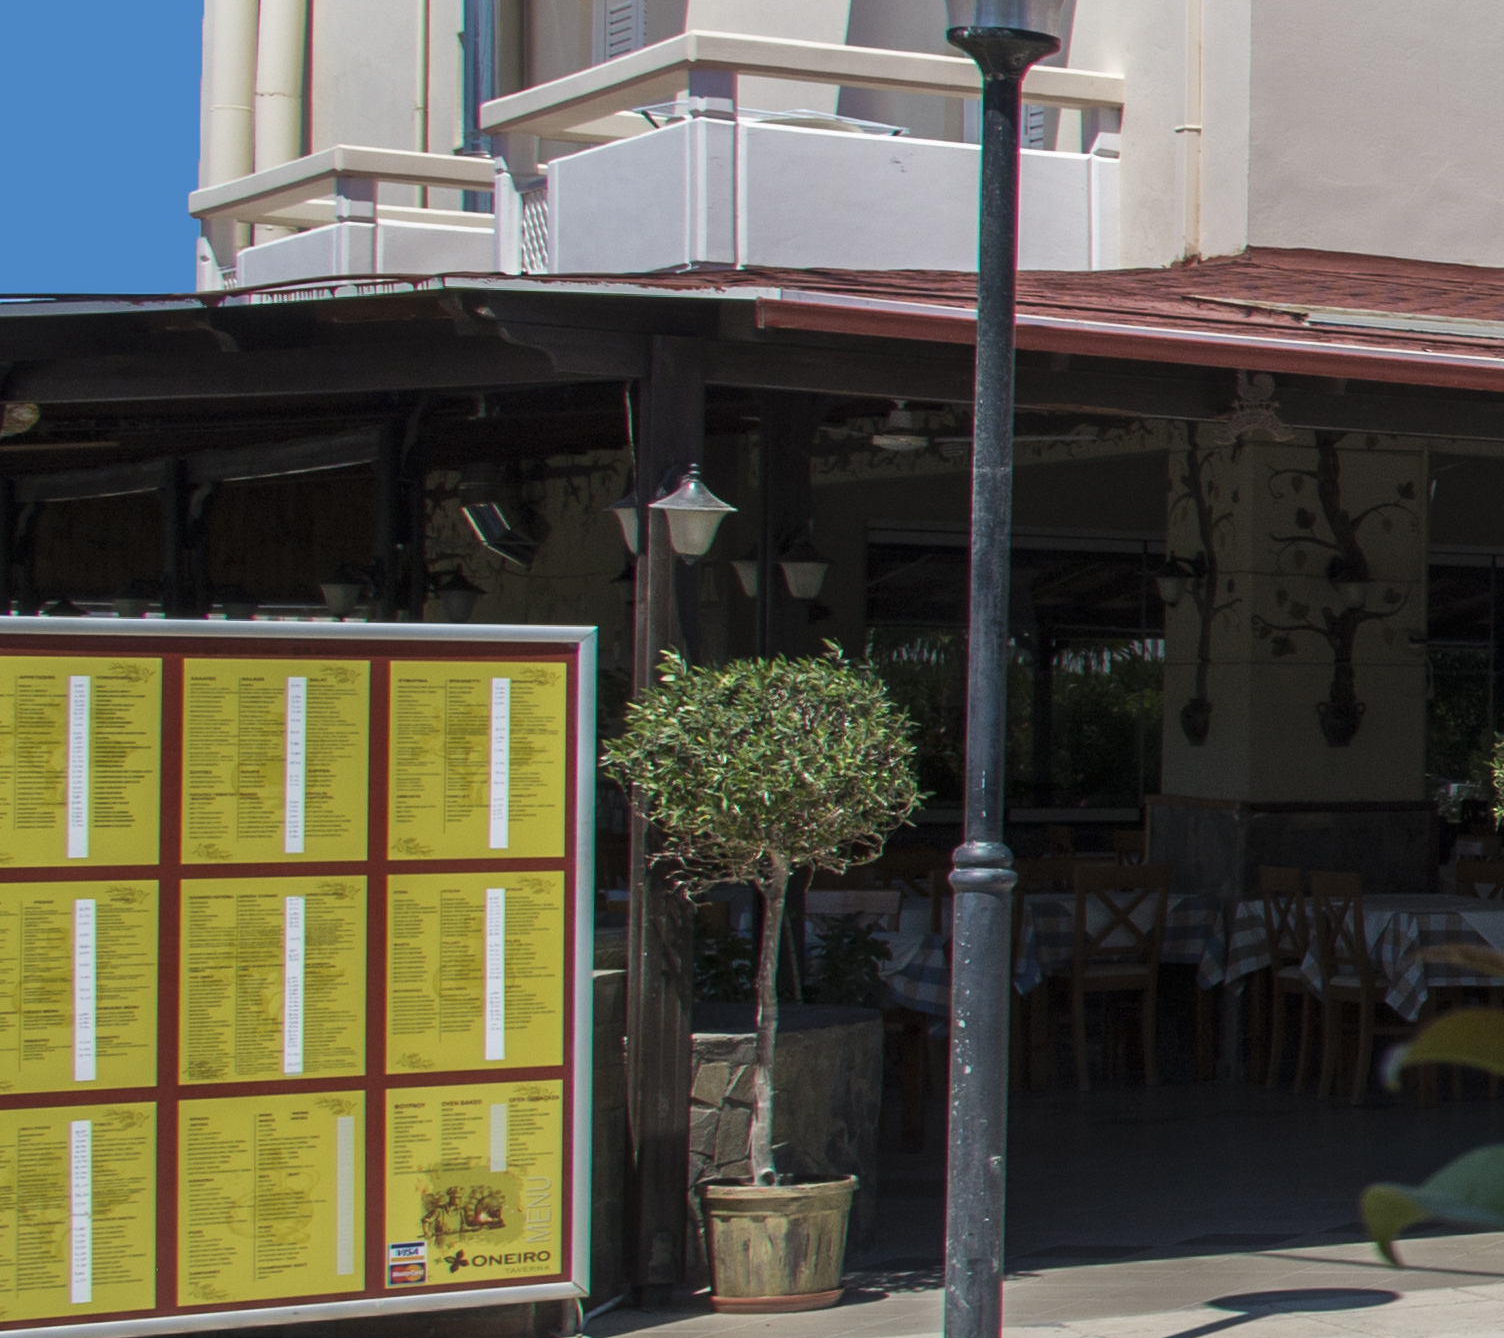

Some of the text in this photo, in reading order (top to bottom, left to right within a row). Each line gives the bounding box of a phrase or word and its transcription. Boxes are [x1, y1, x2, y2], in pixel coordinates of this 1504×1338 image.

[526, 1176, 553, 1244] MENU
[471, 1250, 552, 1267] ONEIRO
[504, 1265, 551, 1274] TAVERNA
